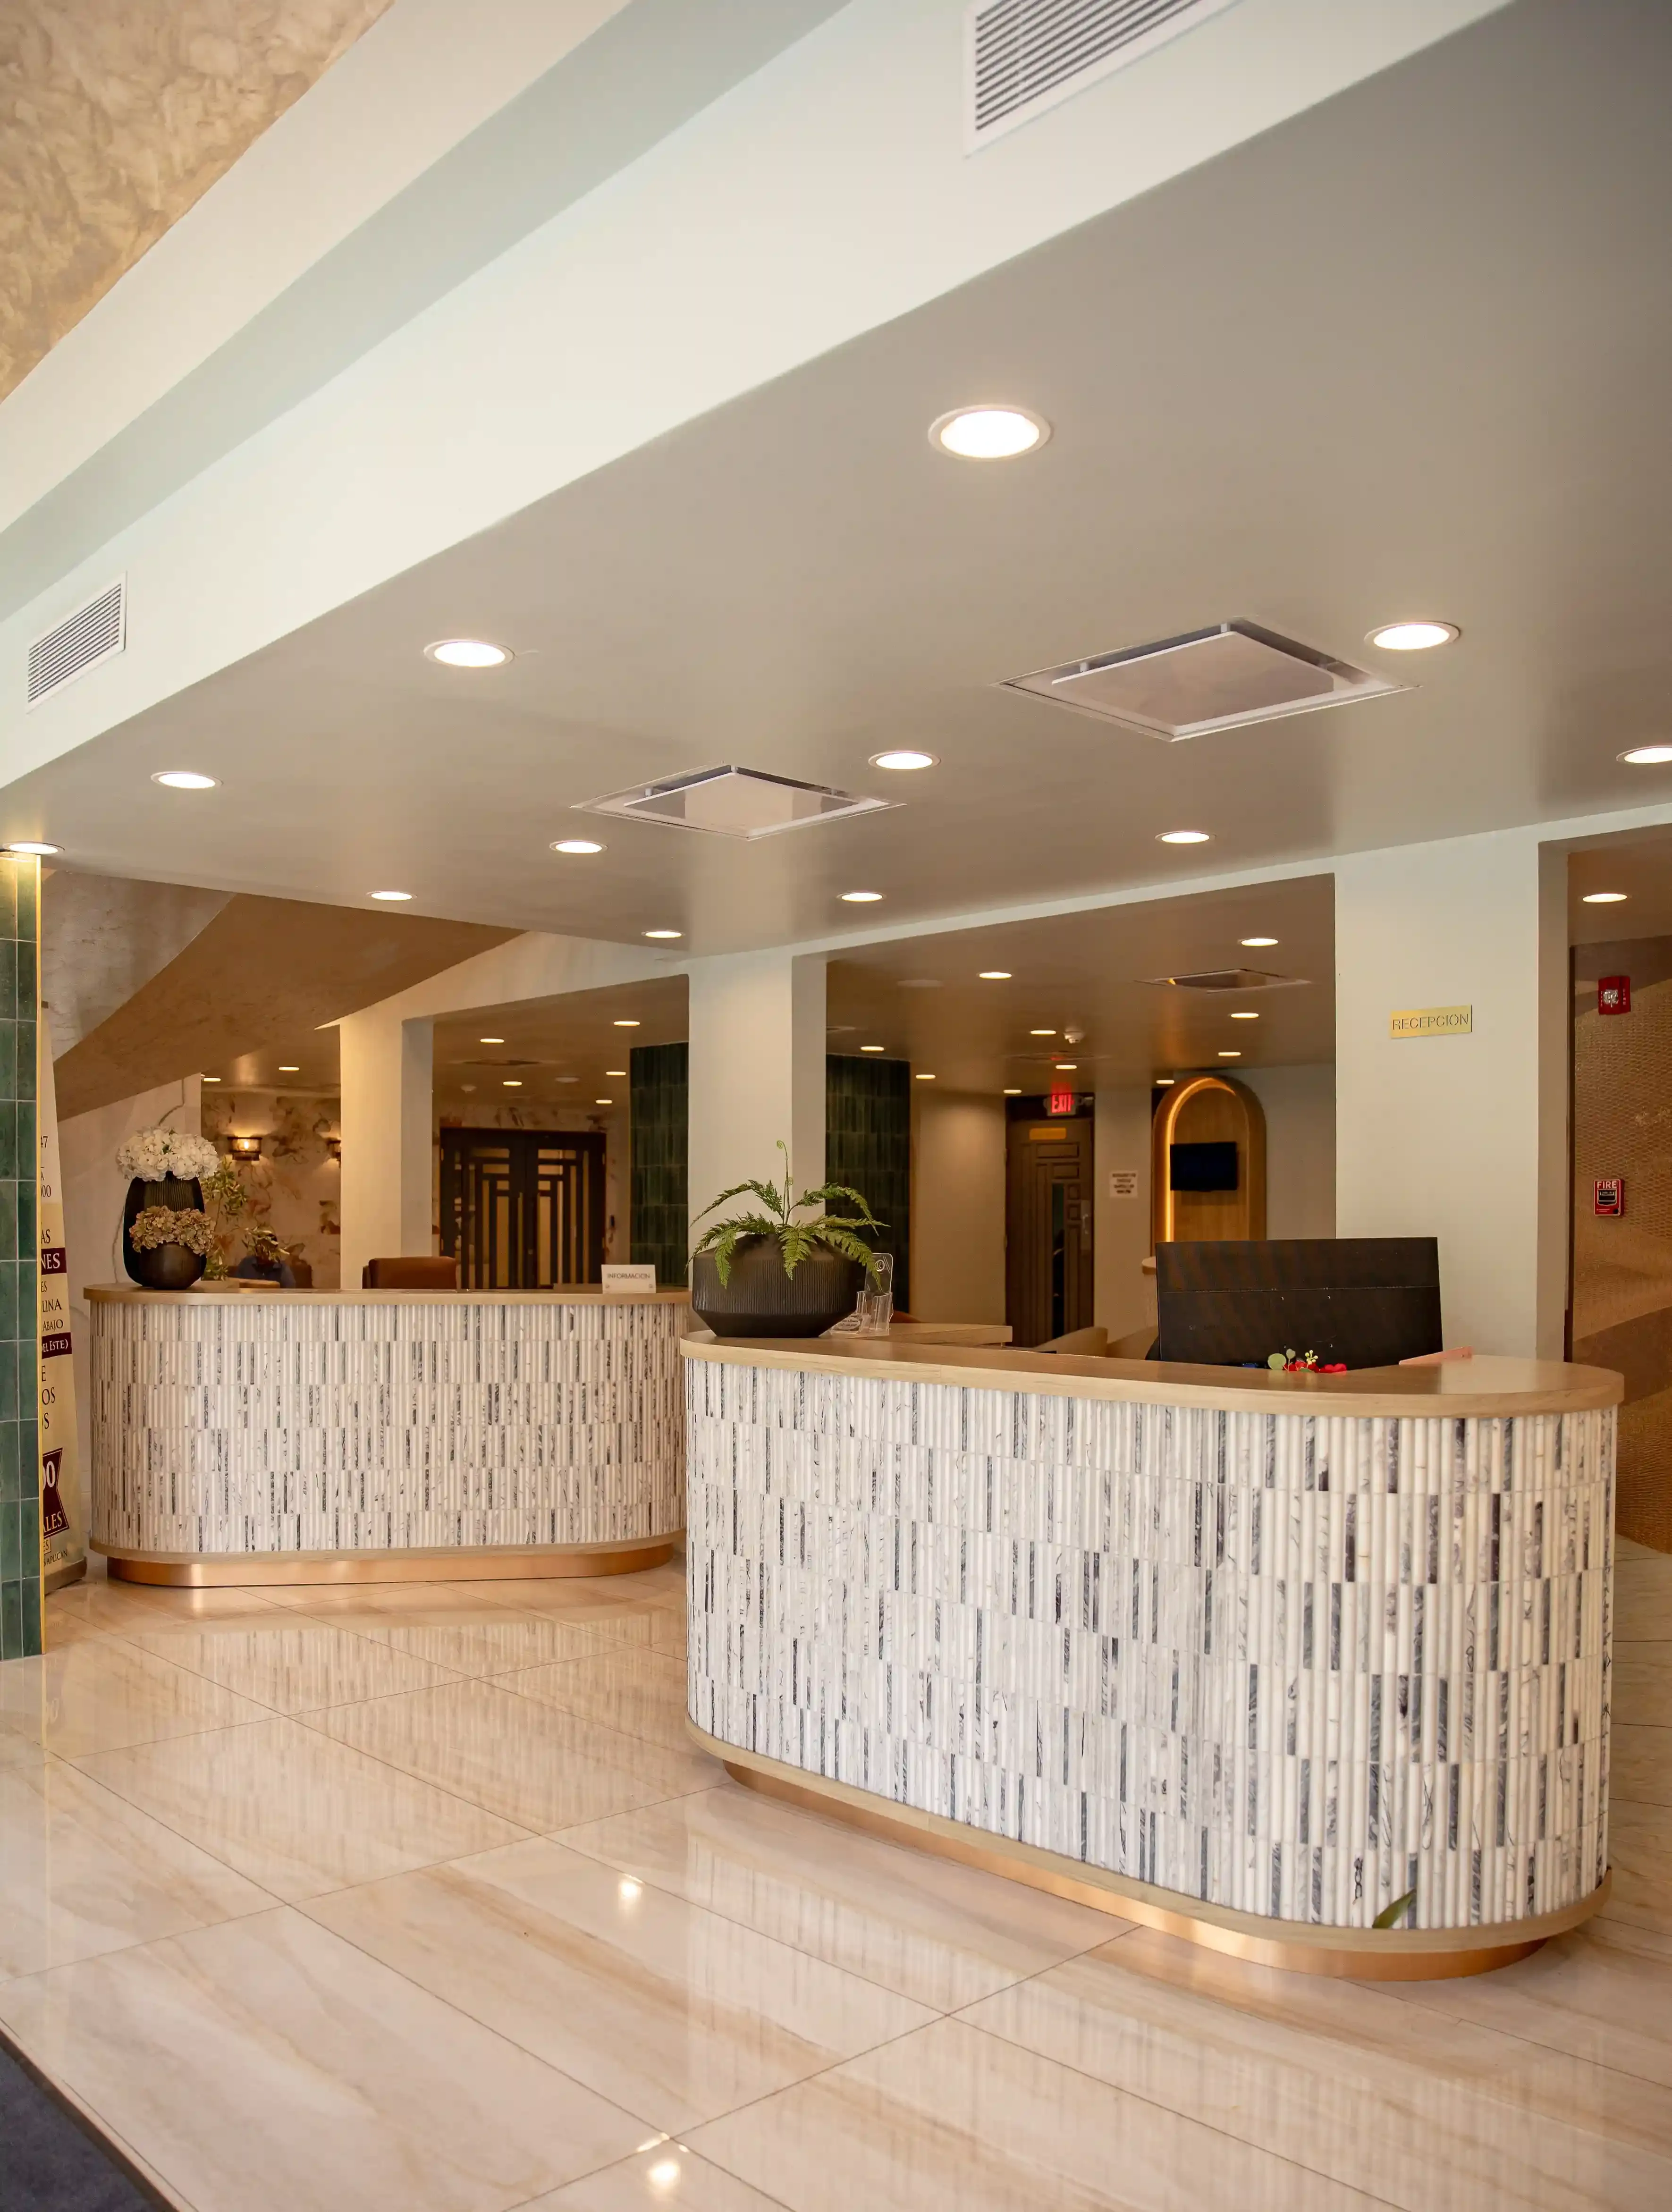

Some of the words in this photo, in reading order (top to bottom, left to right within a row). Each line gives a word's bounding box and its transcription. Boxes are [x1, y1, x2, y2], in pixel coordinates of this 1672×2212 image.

[1393, 1013, 1468, 1030] RECEPCION
[1051, 1094, 1072, 1113] EXIT
[42, 1319, 64, 1332] ABAJO
[42, 1387, 55, 1405] OS
